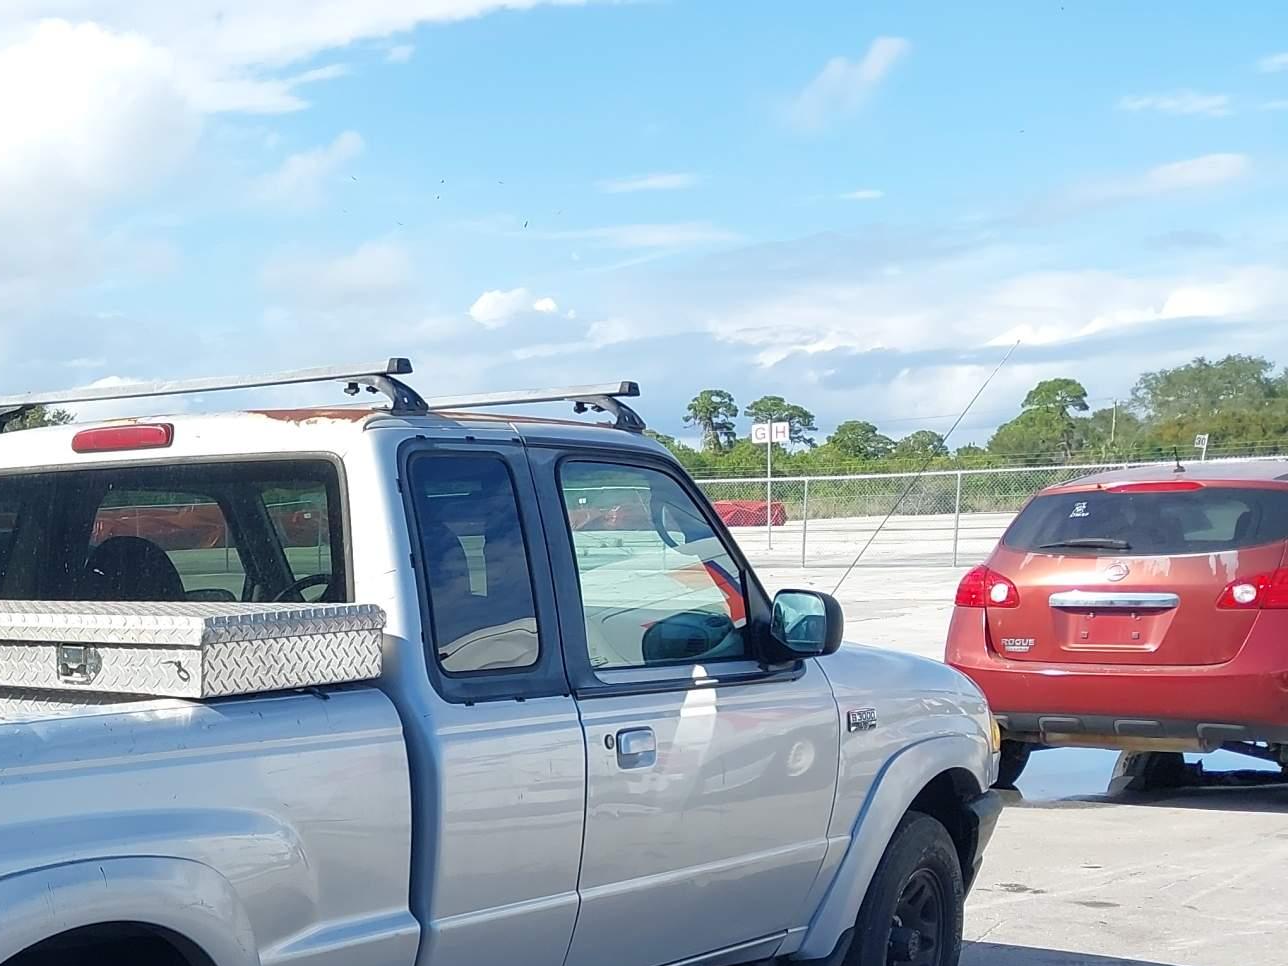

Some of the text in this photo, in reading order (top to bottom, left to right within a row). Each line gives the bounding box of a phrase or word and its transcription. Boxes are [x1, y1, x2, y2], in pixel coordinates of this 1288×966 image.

[755, 425, 787, 441] G H
[1001, 638, 1035, 646] ROGUE
[851, 710, 877, 722] B3000
